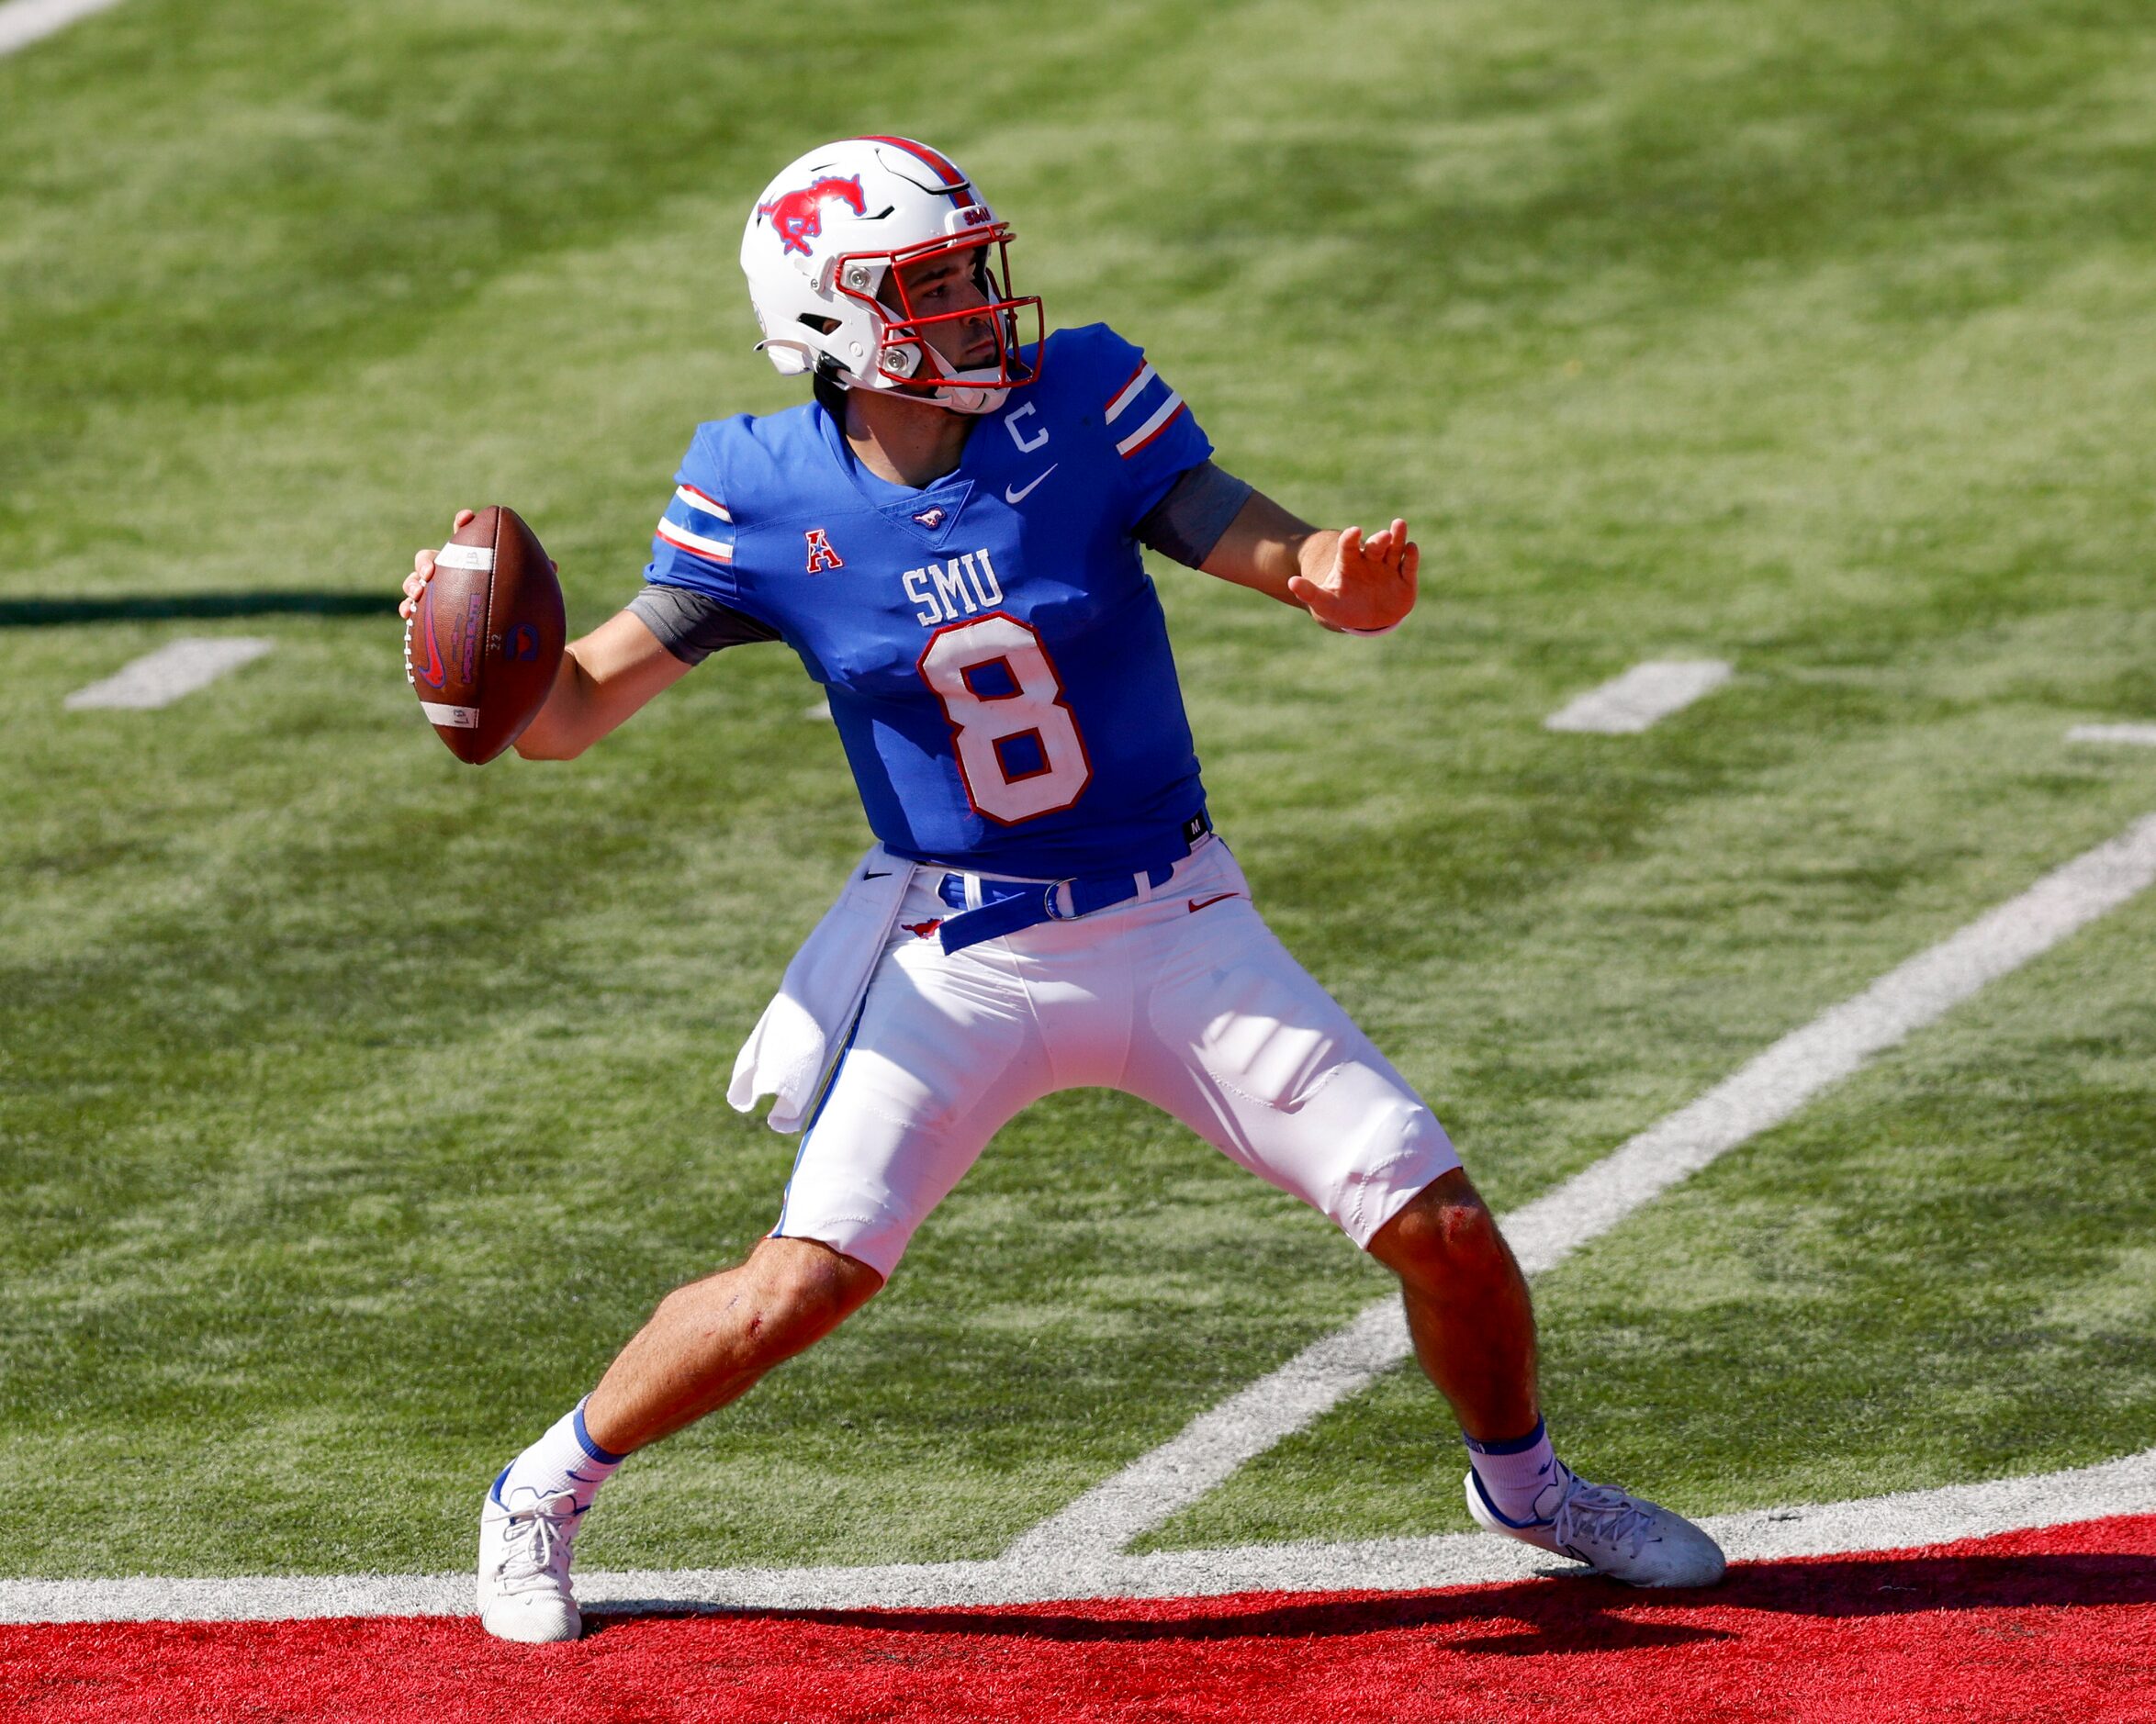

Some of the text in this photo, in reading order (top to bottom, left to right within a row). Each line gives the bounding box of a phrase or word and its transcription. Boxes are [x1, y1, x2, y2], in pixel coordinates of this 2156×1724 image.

[963, 207, 992, 226] SMU
[1004, 400, 1050, 453] C
[805, 529, 843, 574] A
[902, 548, 1004, 627] SMU
[916, 610, 1095, 827] 8
